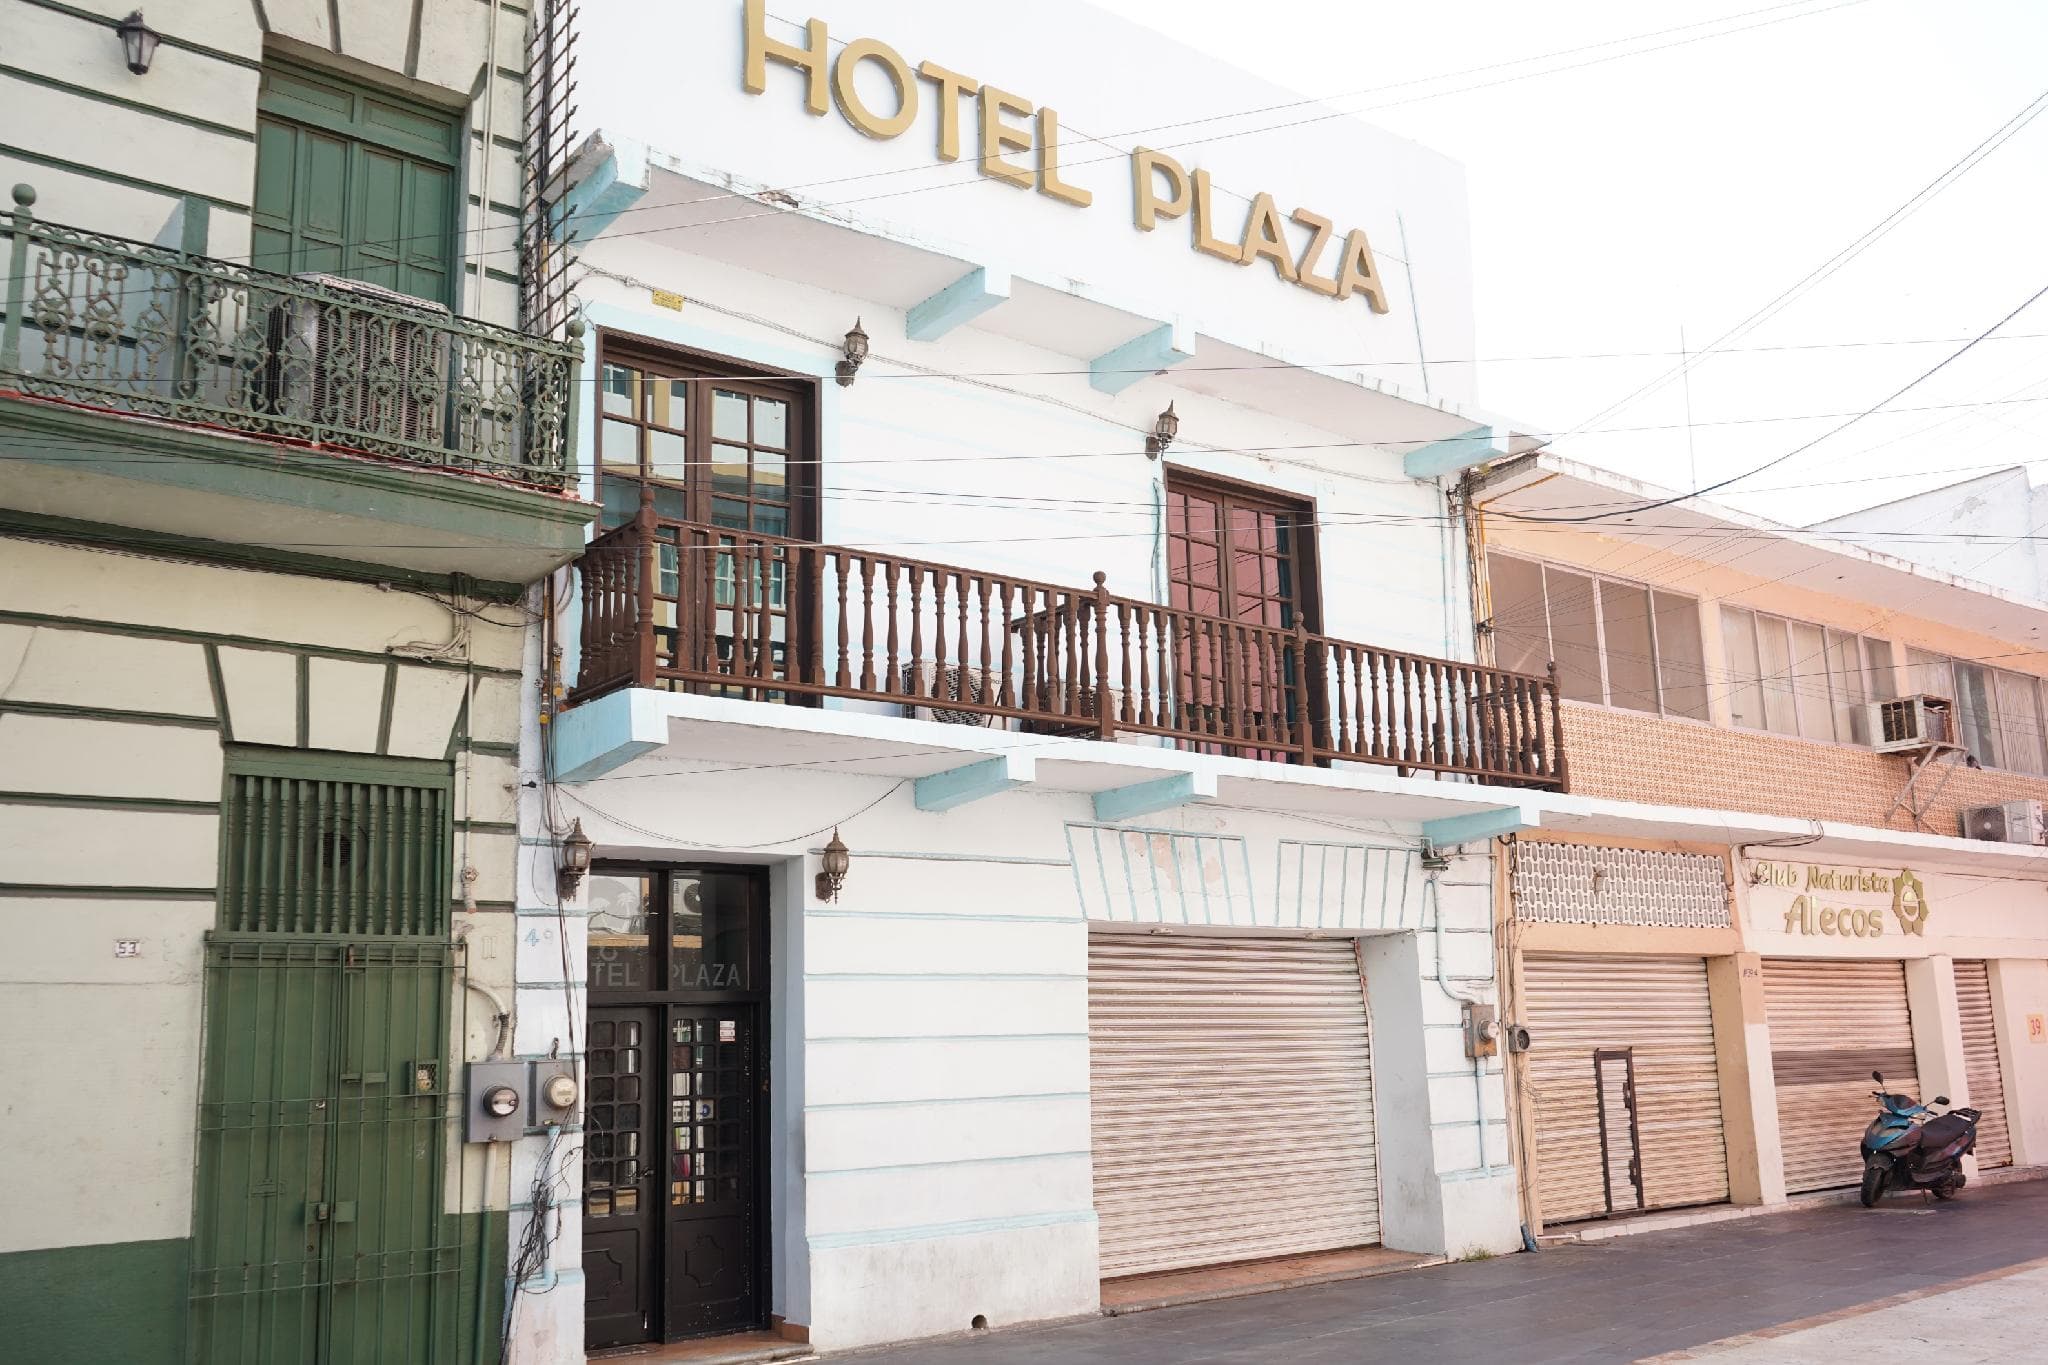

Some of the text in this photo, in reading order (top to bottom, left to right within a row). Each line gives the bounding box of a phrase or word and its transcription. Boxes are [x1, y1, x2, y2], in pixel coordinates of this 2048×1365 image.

[742, 0, 1390, 316] HOTEL PLAZA
[1754, 861, 1891, 893] Club Naturista
[1783, 894, 1885, 938] Alecos
[118, 940, 137, 955] 53
[2029, 1017, 2041, 1037] 39
